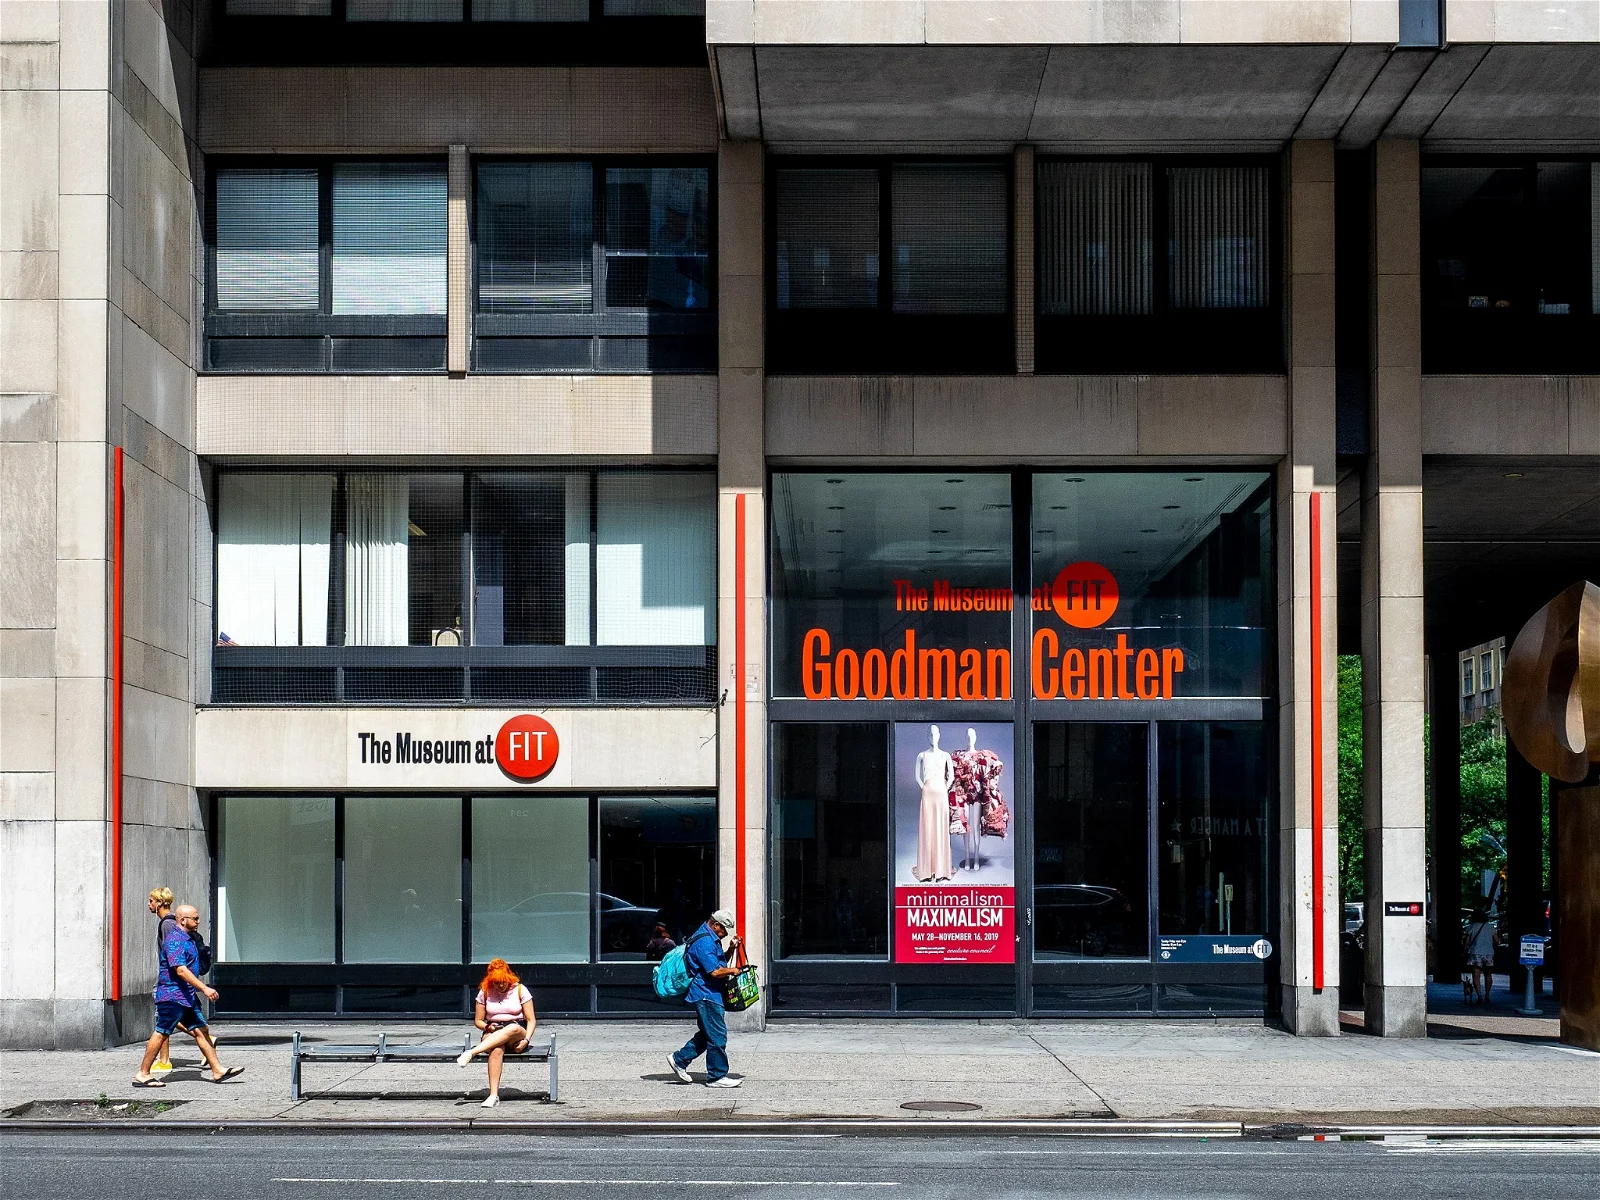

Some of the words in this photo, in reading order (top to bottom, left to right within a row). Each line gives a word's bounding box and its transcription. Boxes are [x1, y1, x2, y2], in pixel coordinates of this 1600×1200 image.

[892, 580, 928, 612] The
[933, 580, 1013, 612] Museum
[1031, 582, 1052, 612] at
[1067, 580, 1105, 611] FIT
[802, 628, 1010, 700] Goodman
[1032, 628, 1184, 700] Center
[358, 733, 391, 764] The
[396, 733, 471, 764] Museum
[475, 735, 494, 764] at
[509, 731, 548, 761] FIT
[907, 890, 1003, 906] minimalism
[907, 908, 1003, 927] MAXIMALISM
[912, 933, 925, 941] MAY
[974, 933, 982, 942] 16,
[984, 933, 999, 941] 2019
[969, 944, 996, 954] council
[1212, 944, 1224, 954] The
[1224, 944, 1247, 954] Museum
[1247, 945, 1254, 954] at
[1257, 945, 1269, 954] FIT
